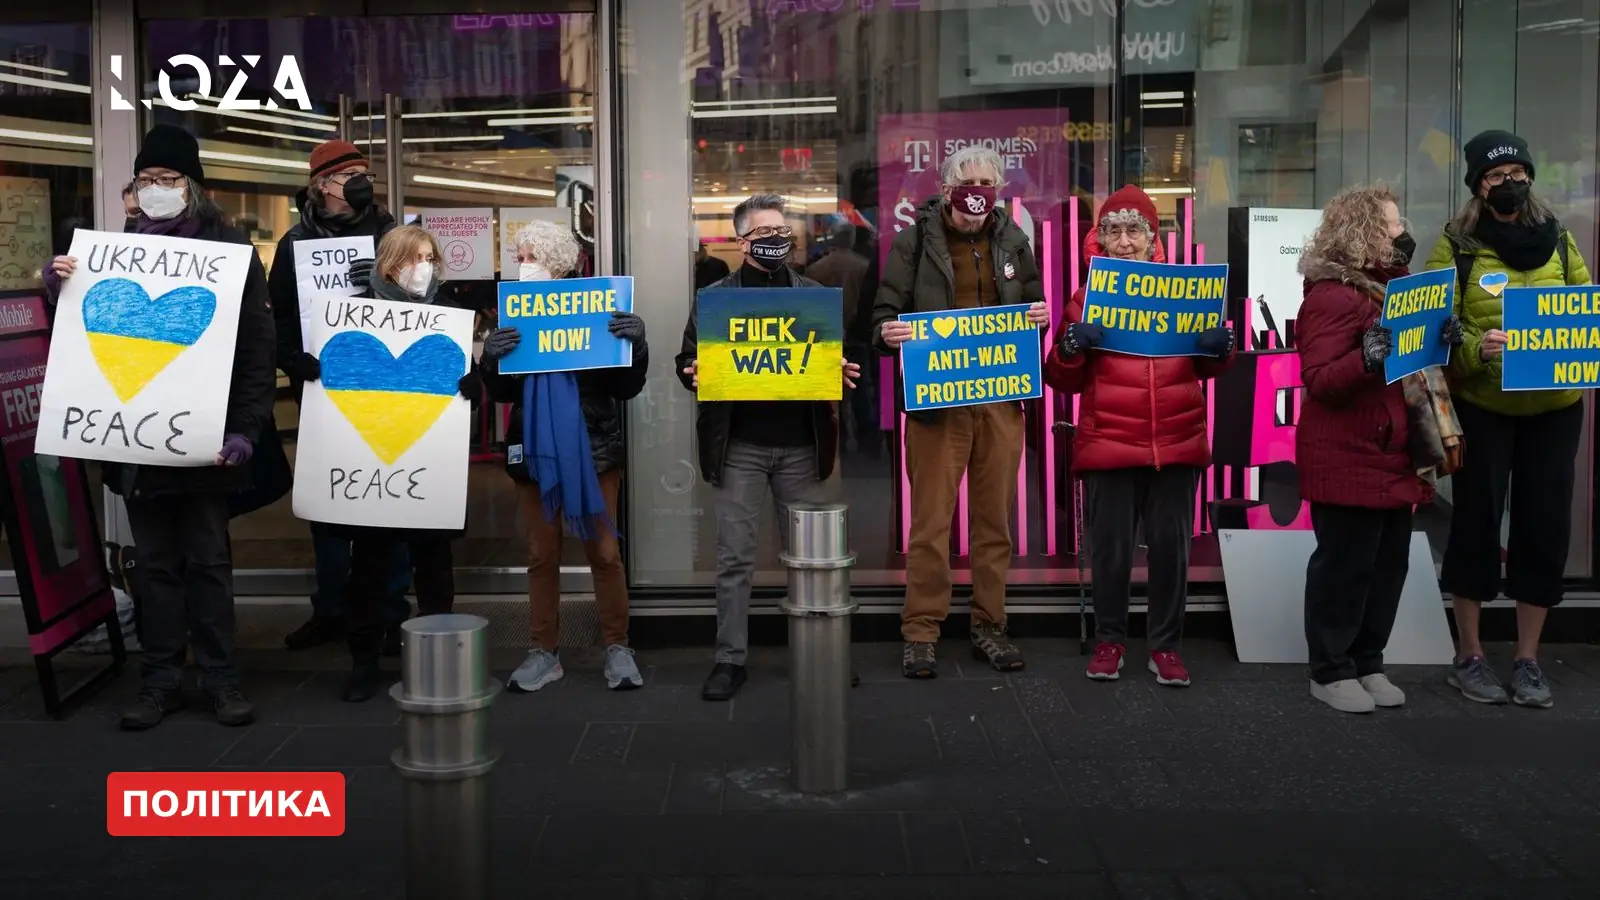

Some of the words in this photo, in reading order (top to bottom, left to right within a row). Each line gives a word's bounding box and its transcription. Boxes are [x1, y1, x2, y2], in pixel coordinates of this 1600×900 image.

[970, 137, 1020, 153] HOME
[1486, 146, 1518, 160] RESIST
[425, 216, 449, 224] MASKS
[1253, 214, 1279, 223] SAMSUNG
[88, 244, 227, 284] UKRAINE
[311, 248, 358, 266] STOP
[1090, 269, 1120, 294] WE
[1125, 273, 1226, 299] CONDEMN
[324, 300, 447, 332] UKRAINE
[506, 289, 617, 318] CEASEFIRE
[1386, 283, 1448, 320] CEASEFIRE
[1537, 292, 1600, 316] NUCLE
[729, 317, 797, 342] FUCK
[1087, 304, 1170, 334] PUTIN'S
[1175, 312, 1220, 334] WAR
[538, 327, 591, 353] NOW!
[1398, 324, 1426, 357] NOW!
[1506, 327, 1600, 351] DISARMA
[928, 343, 1017, 372] ANTI-WAR
[1553, 361, 1600, 384] NOW
[916, 374, 1032, 405] PROTESTORS
[62, 406, 191, 456] PEACE
[331, 467, 427, 500] PEACE
